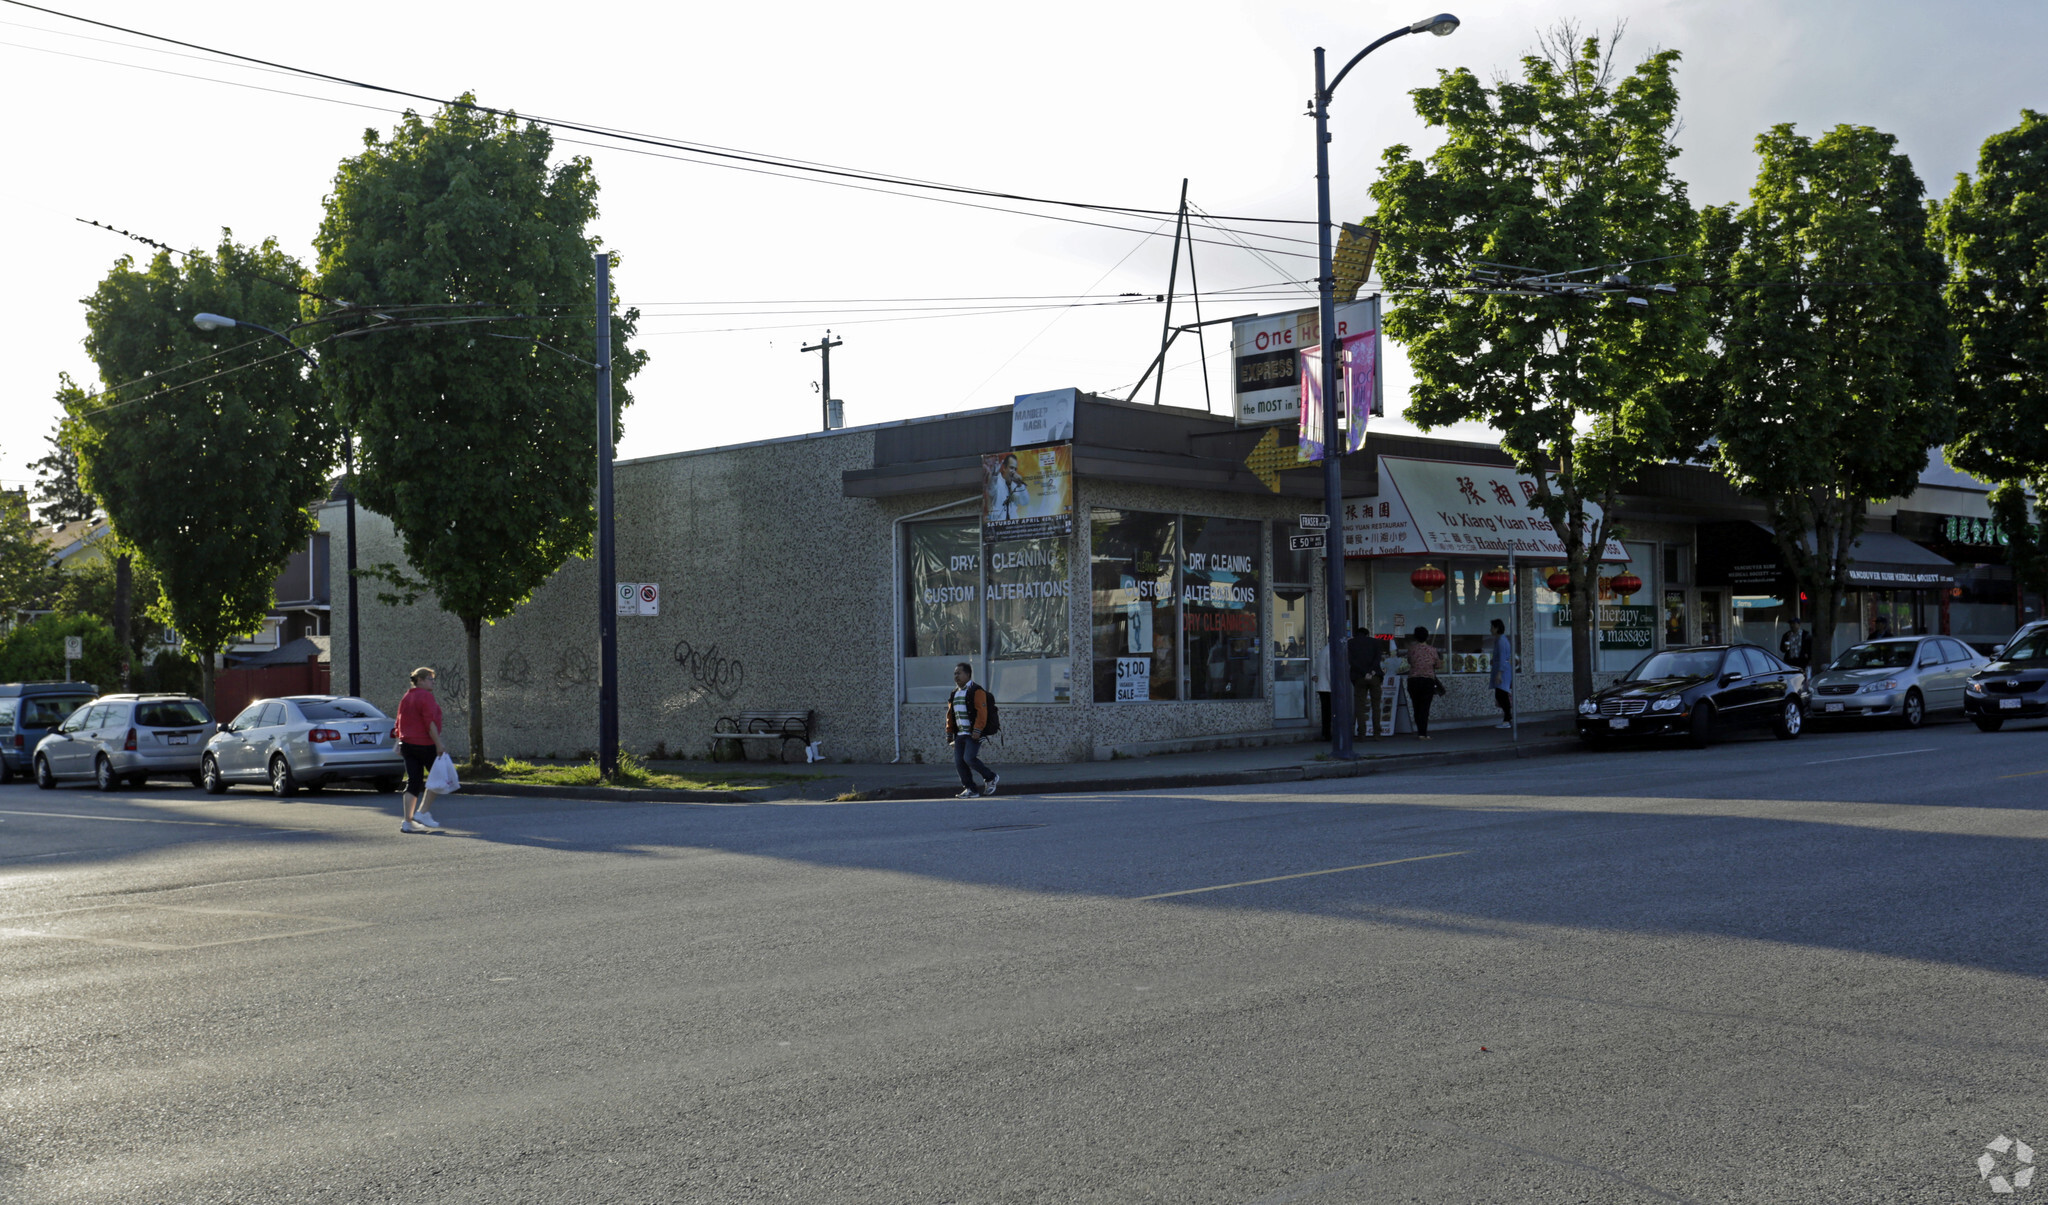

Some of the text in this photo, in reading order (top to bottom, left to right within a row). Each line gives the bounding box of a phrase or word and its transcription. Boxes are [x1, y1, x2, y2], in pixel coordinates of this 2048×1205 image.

[1302, 321, 1348, 342] HOR
[1241, 357, 1294, 384] EXPRESS
[1015, 408, 1048, 422] MANDEEP
[1243, 404, 1255, 414] the
[1257, 399, 1282, 413] MOST
[1023, 419, 1047, 432] NAGRA
[987, 518, 1019, 527] SATURDAY
[1021, 516, 1040, 525] APRIL
[1302, 516, 1319, 527] FRASER
[1372, 521, 1408, 529] RESTAURANT
[1437, 512, 1458, 527] Yu
[1460, 514, 1498, 533] Xiang
[1494, 515, 1528, 531] Yuan
[1292, 538, 1298, 548] E
[1379, 545, 1405, 554] Noodle
[1474, 536, 1541, 552] Handcafted
[1539, 539, 1567, 553] Nood
[951, 548, 1057, 572] DRY CLEANING
[1189, 552, 1252, 573] DRY CLEANING
[1849, 570, 1880, 580] VANCOUVER
[1895, 573, 1917, 582] MEDICAL
[1917, 574, 1939, 582] SOCIETY
[924, 580, 1071, 604] CUSTOM ALTERATIONS
[1124, 580, 1255, 603] CUSTOM ALTERATIONS
[1183, 612, 1201, 632] DRY
[1608, 629, 1650, 647] massage
[1117, 660, 1145, 679] $1.00
[1117, 688, 1134, 700] SALE
